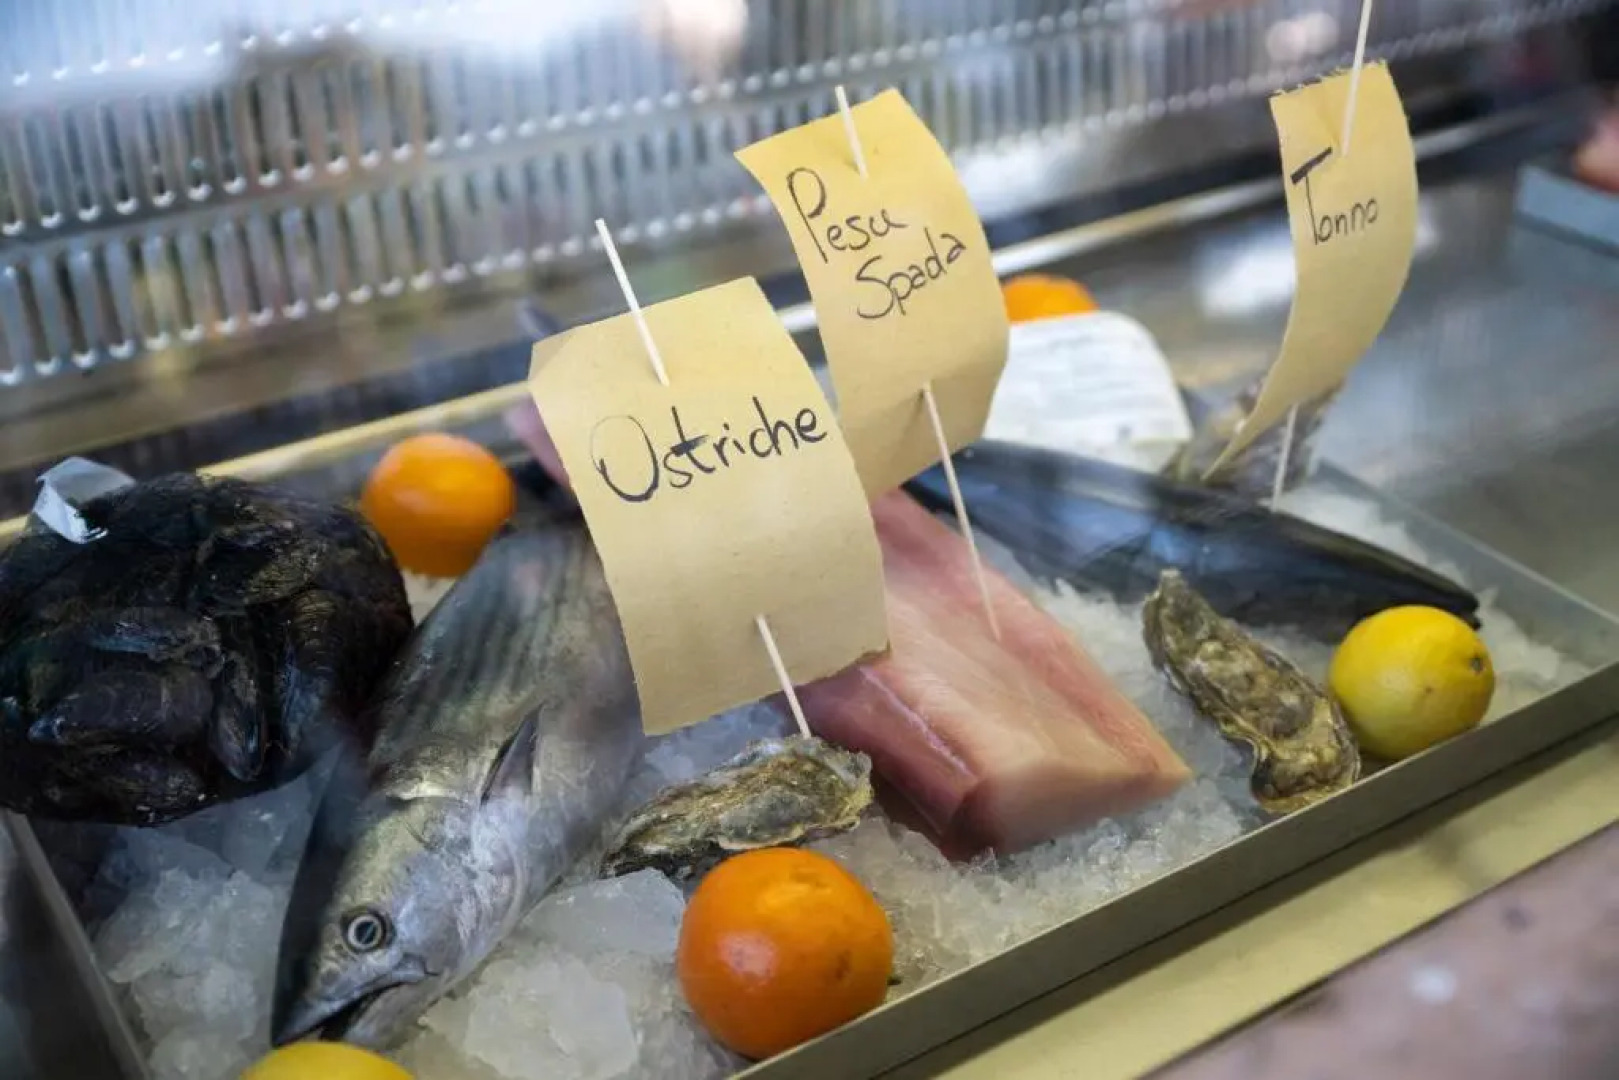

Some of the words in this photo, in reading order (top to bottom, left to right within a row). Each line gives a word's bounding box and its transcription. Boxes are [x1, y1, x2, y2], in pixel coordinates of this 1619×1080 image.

[1290, 146, 1378, 245] Tonno
[856, 227, 966, 319] Spada
[590, 396, 827, 503] Ostriche
